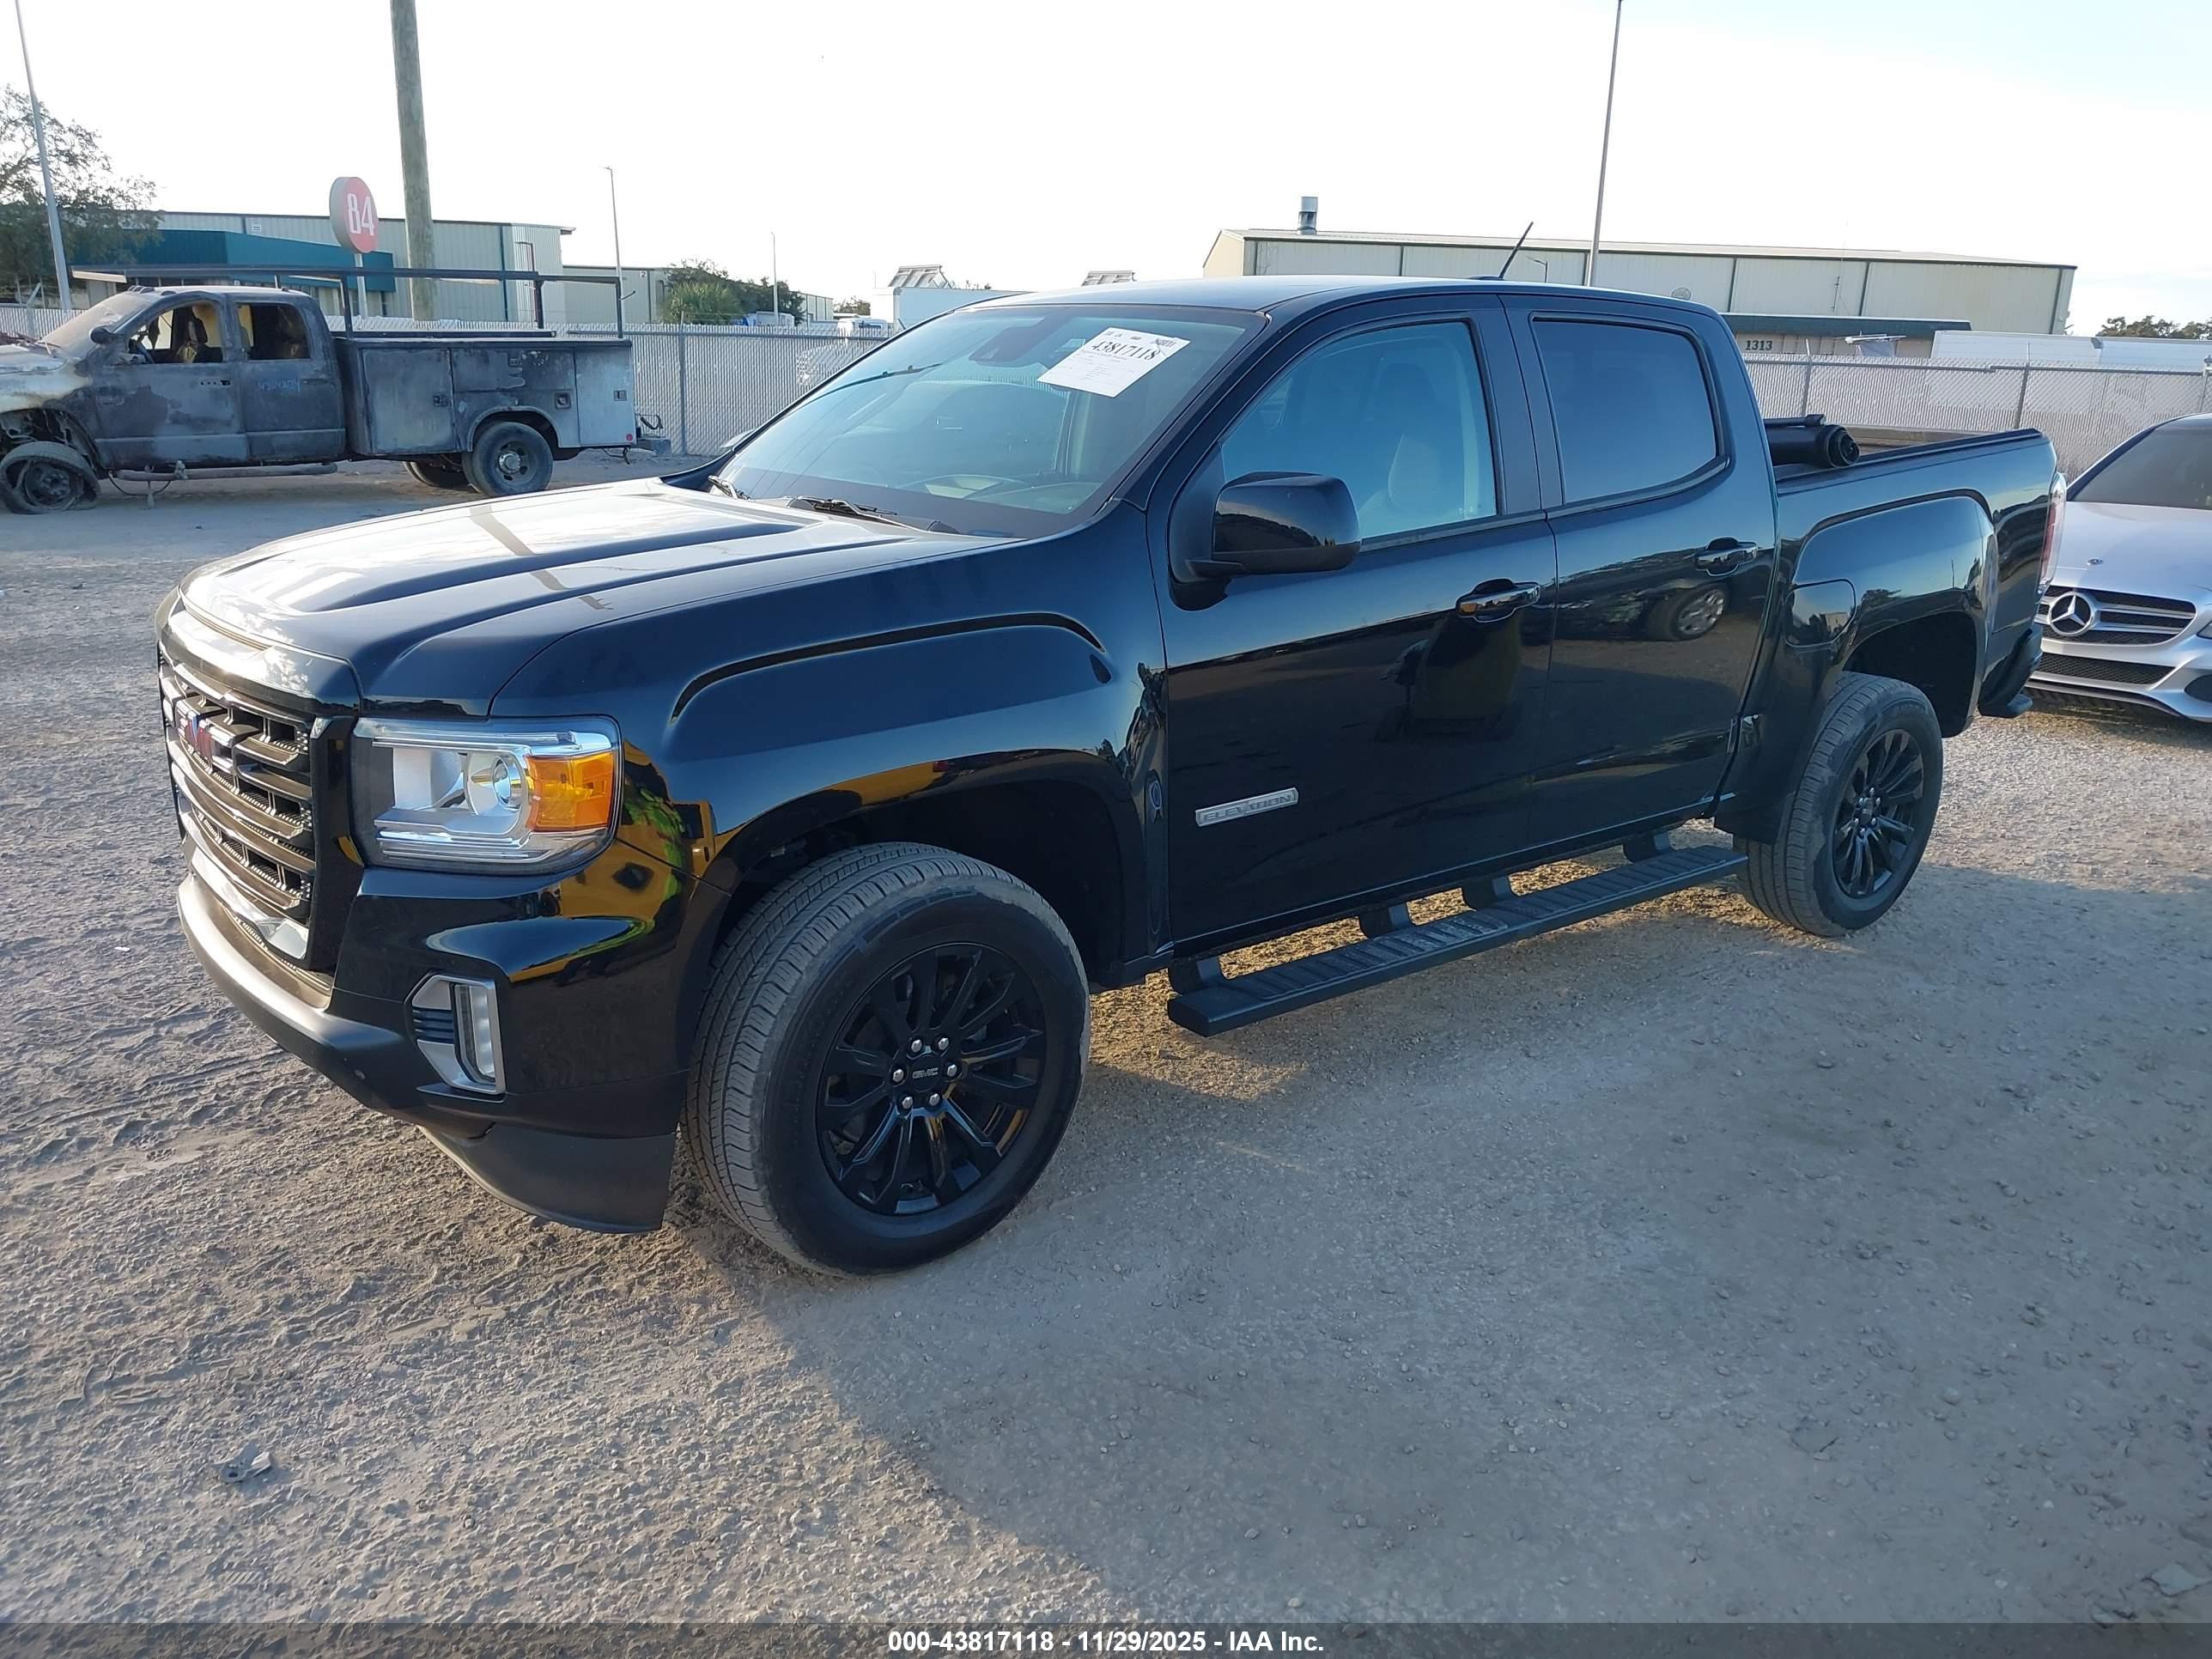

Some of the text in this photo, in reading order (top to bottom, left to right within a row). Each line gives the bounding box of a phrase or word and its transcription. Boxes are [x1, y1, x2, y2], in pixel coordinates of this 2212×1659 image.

[347, 193, 374, 236] 84
[1091, 340, 1161, 361] 43817118
[1745, 340, 1772, 350] 1313
[912, 1066, 939, 1079] GMC
